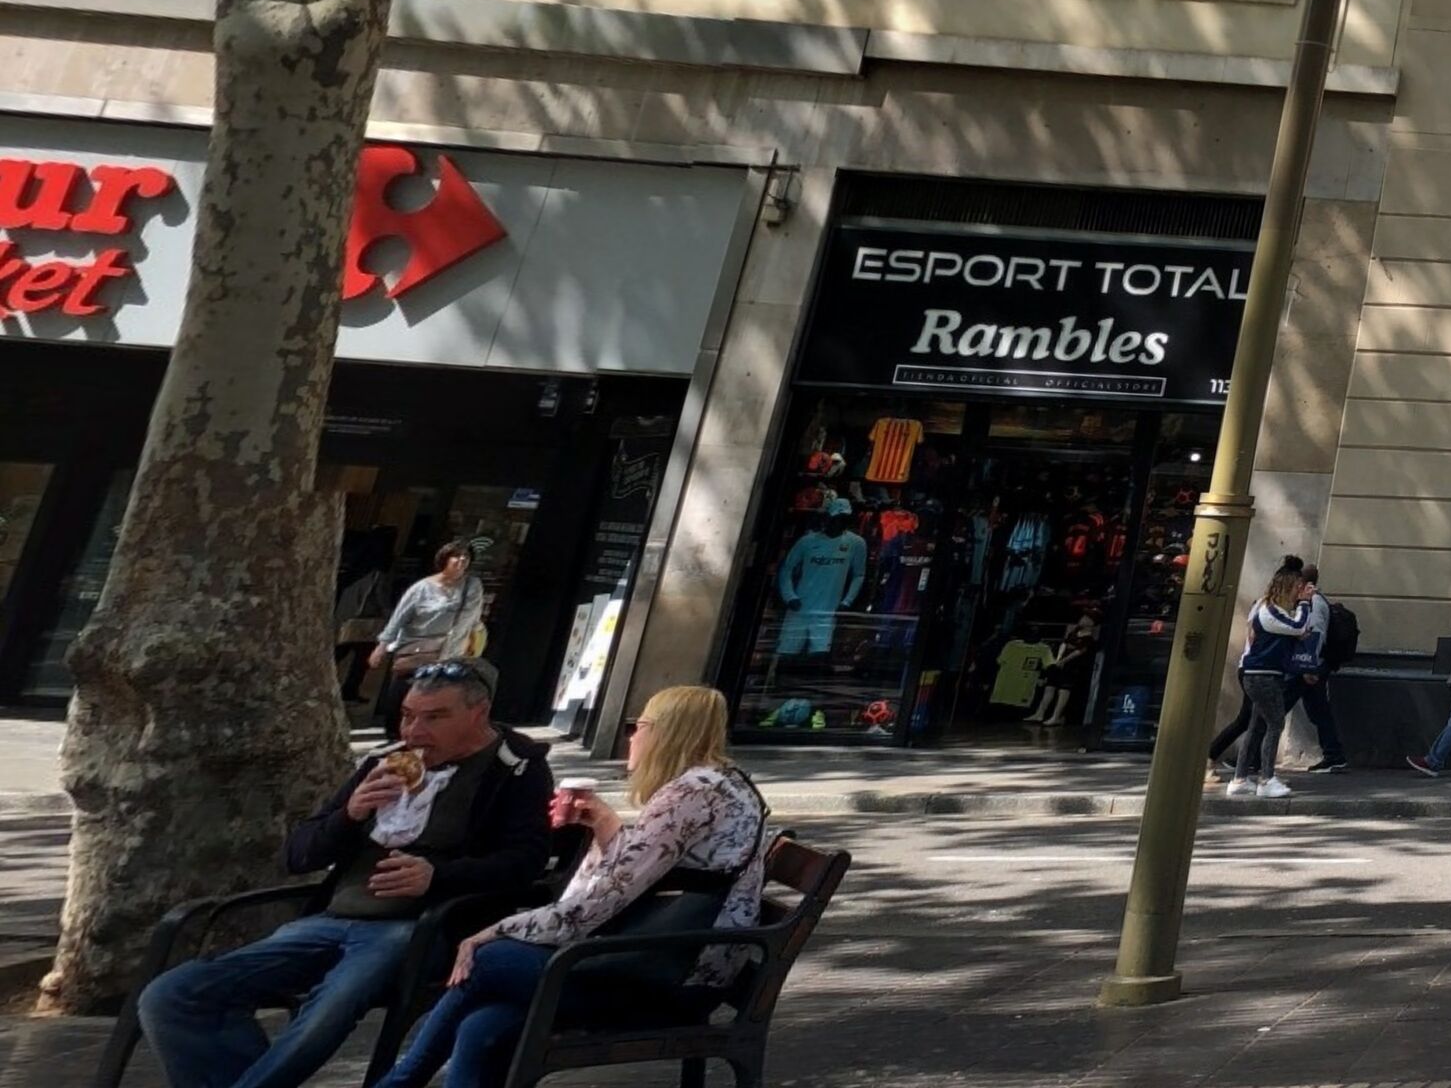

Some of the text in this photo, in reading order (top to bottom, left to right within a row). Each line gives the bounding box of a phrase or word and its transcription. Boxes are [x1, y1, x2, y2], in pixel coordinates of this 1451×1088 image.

[852, 246, 1249, 301] ESPORT TOTAL
[909, 308, 1169, 366] Rambles
[902, 371, 955, 383] TIENDA
